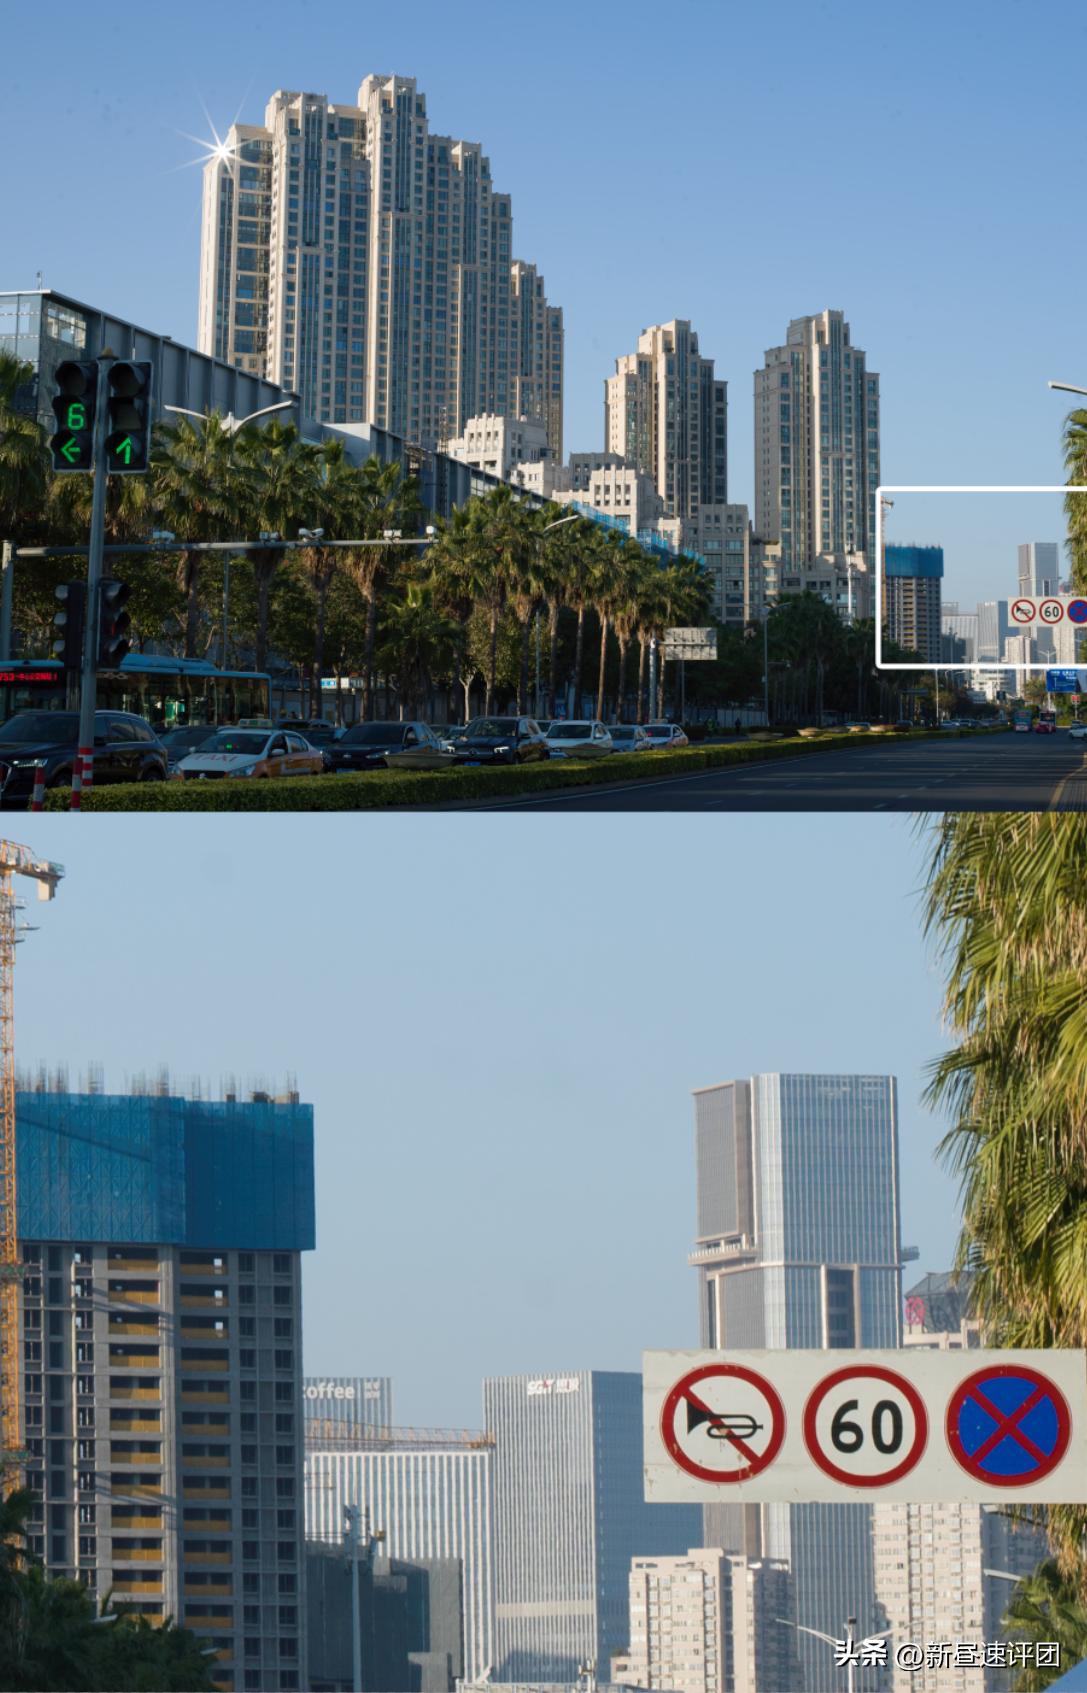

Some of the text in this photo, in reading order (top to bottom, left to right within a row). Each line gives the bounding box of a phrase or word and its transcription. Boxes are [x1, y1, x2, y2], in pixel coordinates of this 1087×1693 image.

[67, 403, 85, 430] 6
[1044, 606, 1060, 618] 60
[831, 1399, 902, 1454] 60
